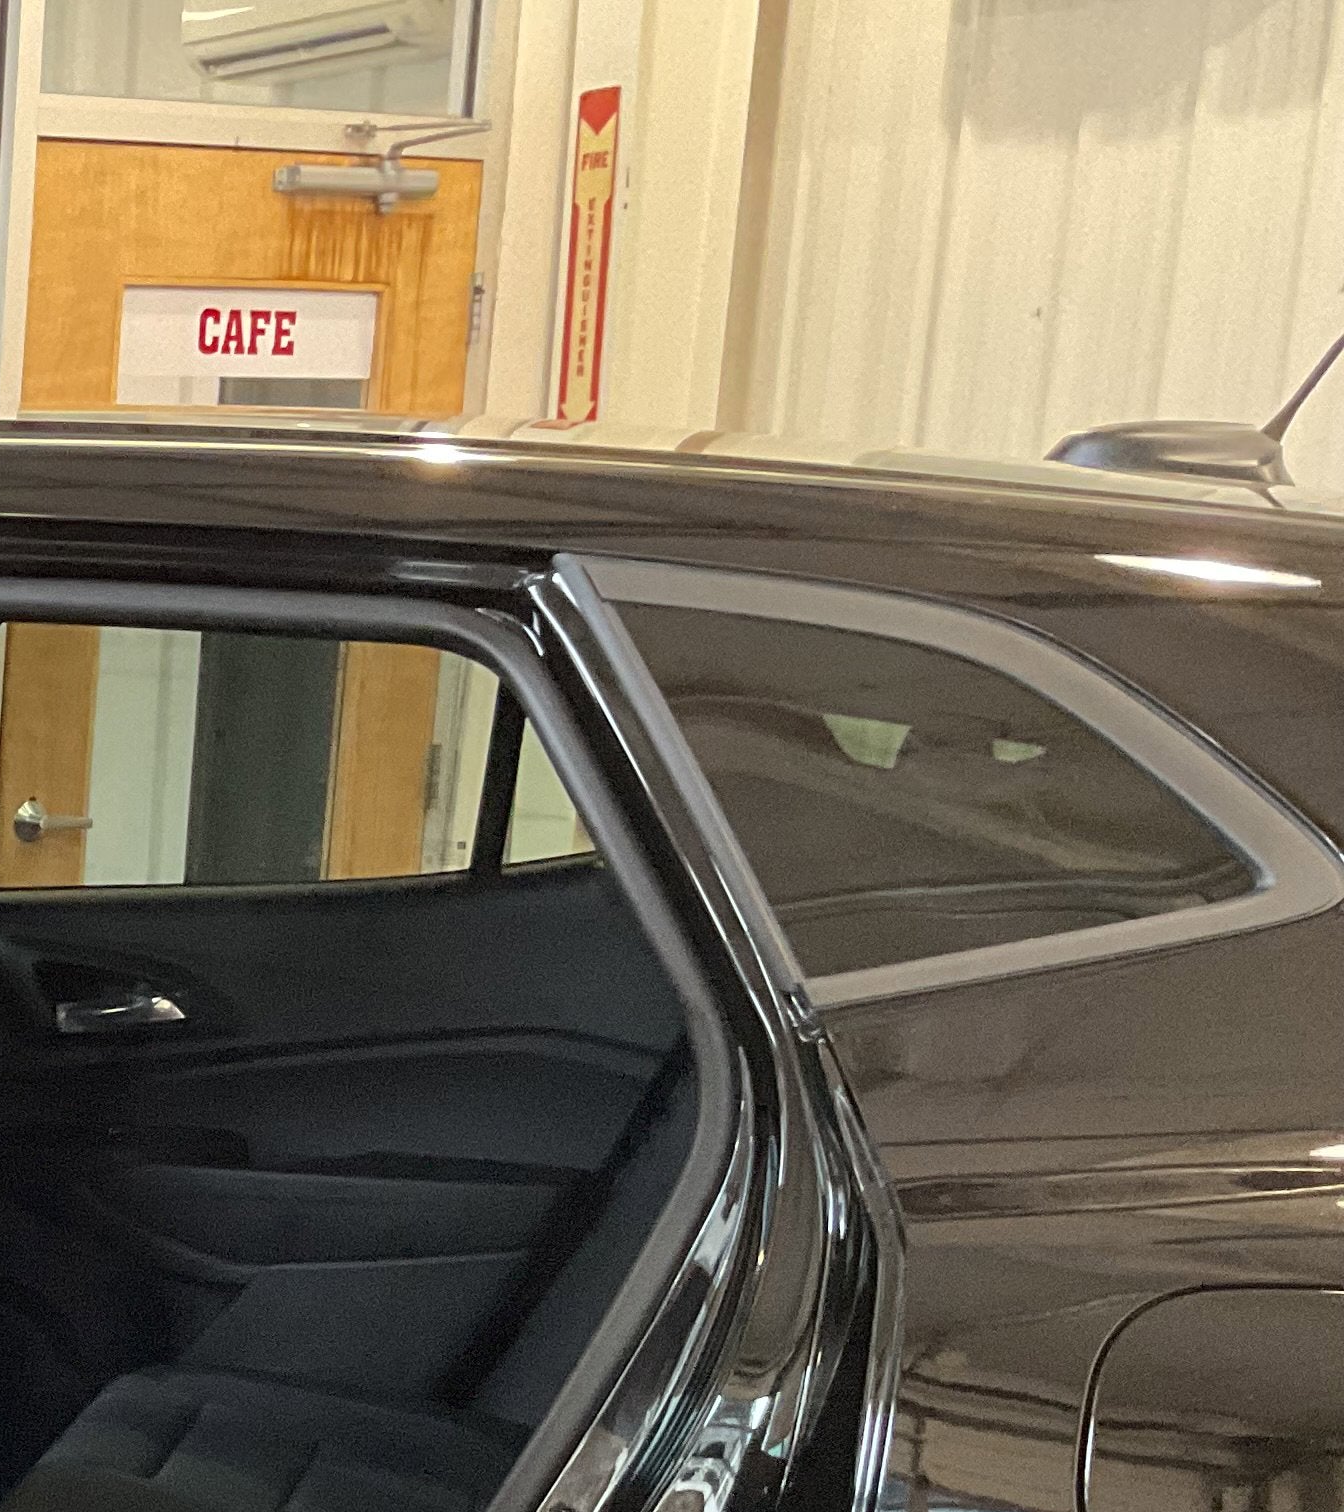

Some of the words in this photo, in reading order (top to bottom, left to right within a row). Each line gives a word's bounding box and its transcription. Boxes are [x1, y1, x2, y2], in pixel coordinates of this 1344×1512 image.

[581, 150, 609, 171] FIRE
[576, 198, 597, 377] EXTINGUISHER
[197, 307, 297, 356] CAFE
